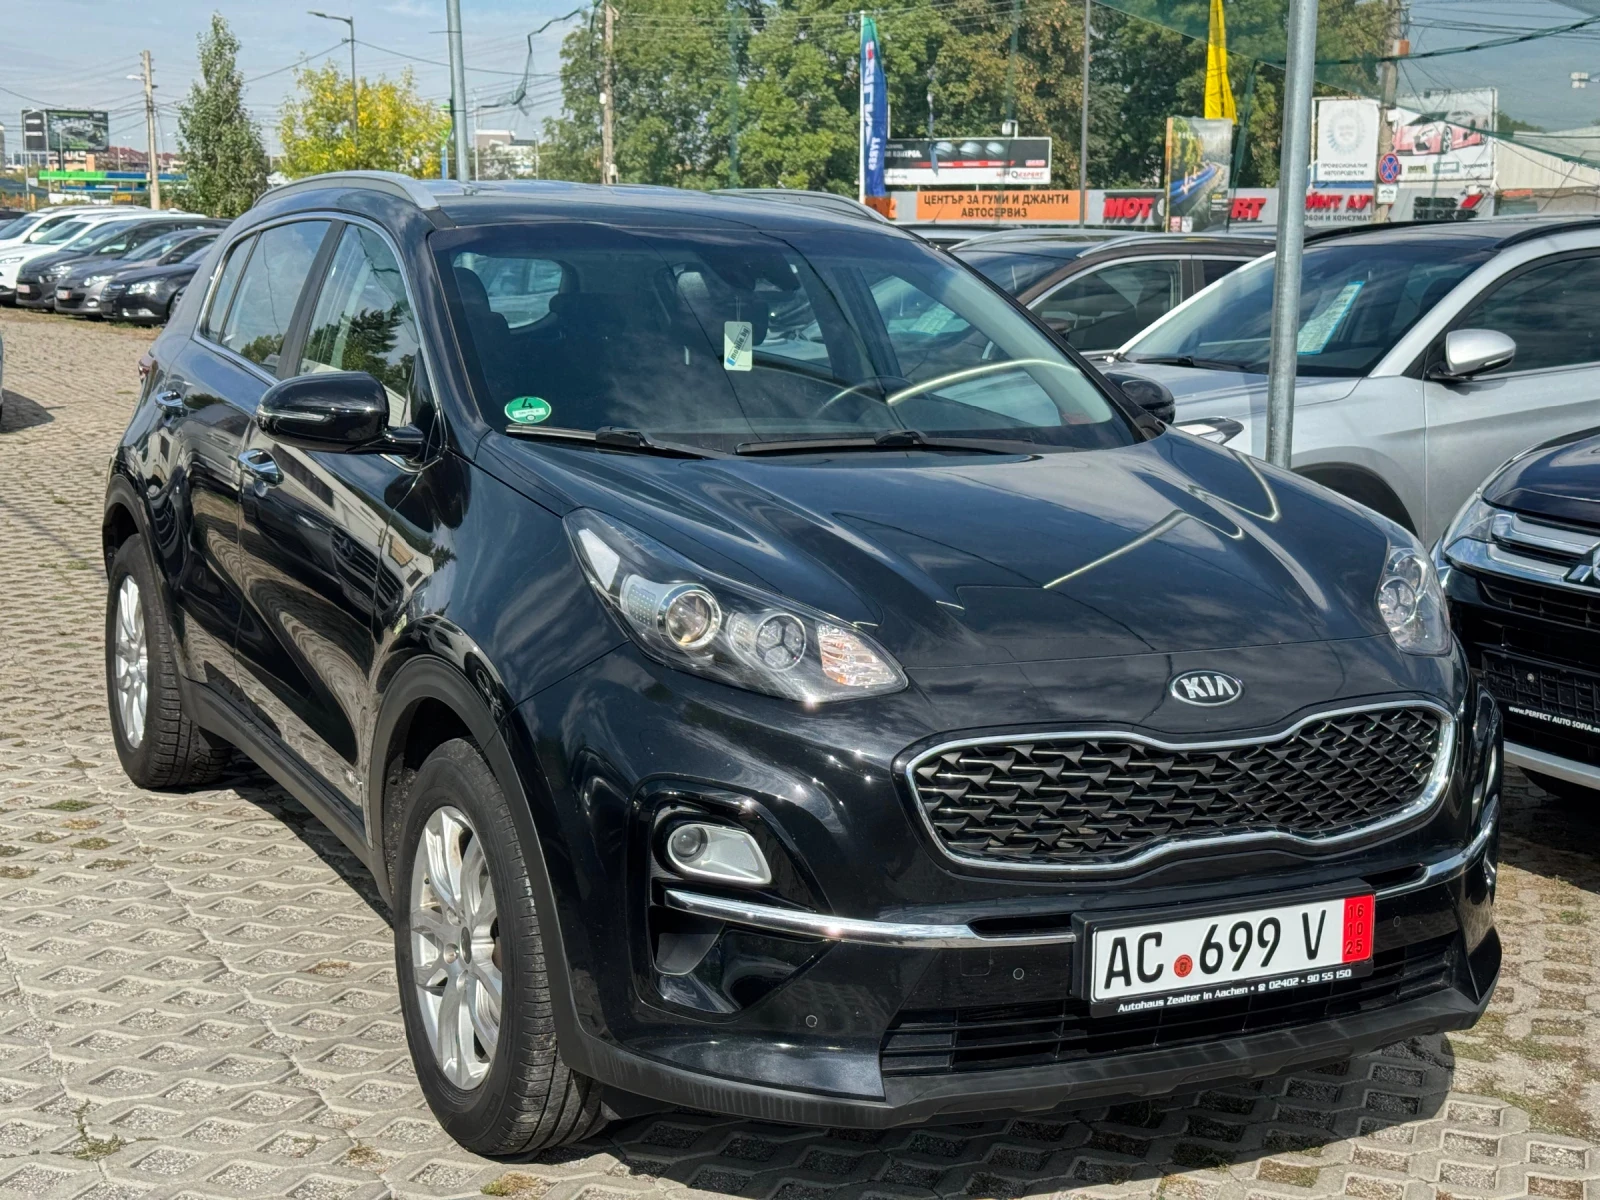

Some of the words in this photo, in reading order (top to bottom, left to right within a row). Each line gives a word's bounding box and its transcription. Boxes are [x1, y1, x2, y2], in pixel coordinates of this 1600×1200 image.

[924, 194, 963, 205] ЦЕНТЪР
[967, 194, 979, 205] ЗА
[982, 194, 1009, 204] ГУМИ
[1012, 194, 1019, 204] И
[1022, 194, 1069, 206] ДЖАНТИ
[961, 207, 1028, 218] АВТОСЕРВИЗ
[521, 397, 534, 409] 4
[1180, 675, 1235, 699] KIA
[1508, 705, 1552, 722] www.PERFECT
[1552, 715, 1571, 727] AUTO
[1349, 904, 1364, 919] 16
[1348, 921, 1363, 937] 10
[1103, 931, 1164, 990] AC
[1199, 916, 1281, 975] 699
[1301, 909, 1327, 961] V
[1346, 939, 1363, 955] 25
[1117, 999, 1164, 1013] Autohaus
[1214, 986, 1248, 998] Aachen
[1268, 977, 1299, 990] 02402
[1306, 974, 1320, 984] 90
[1321, 972, 1334, 981] 55
[1335, 969, 1352, 979] 150
